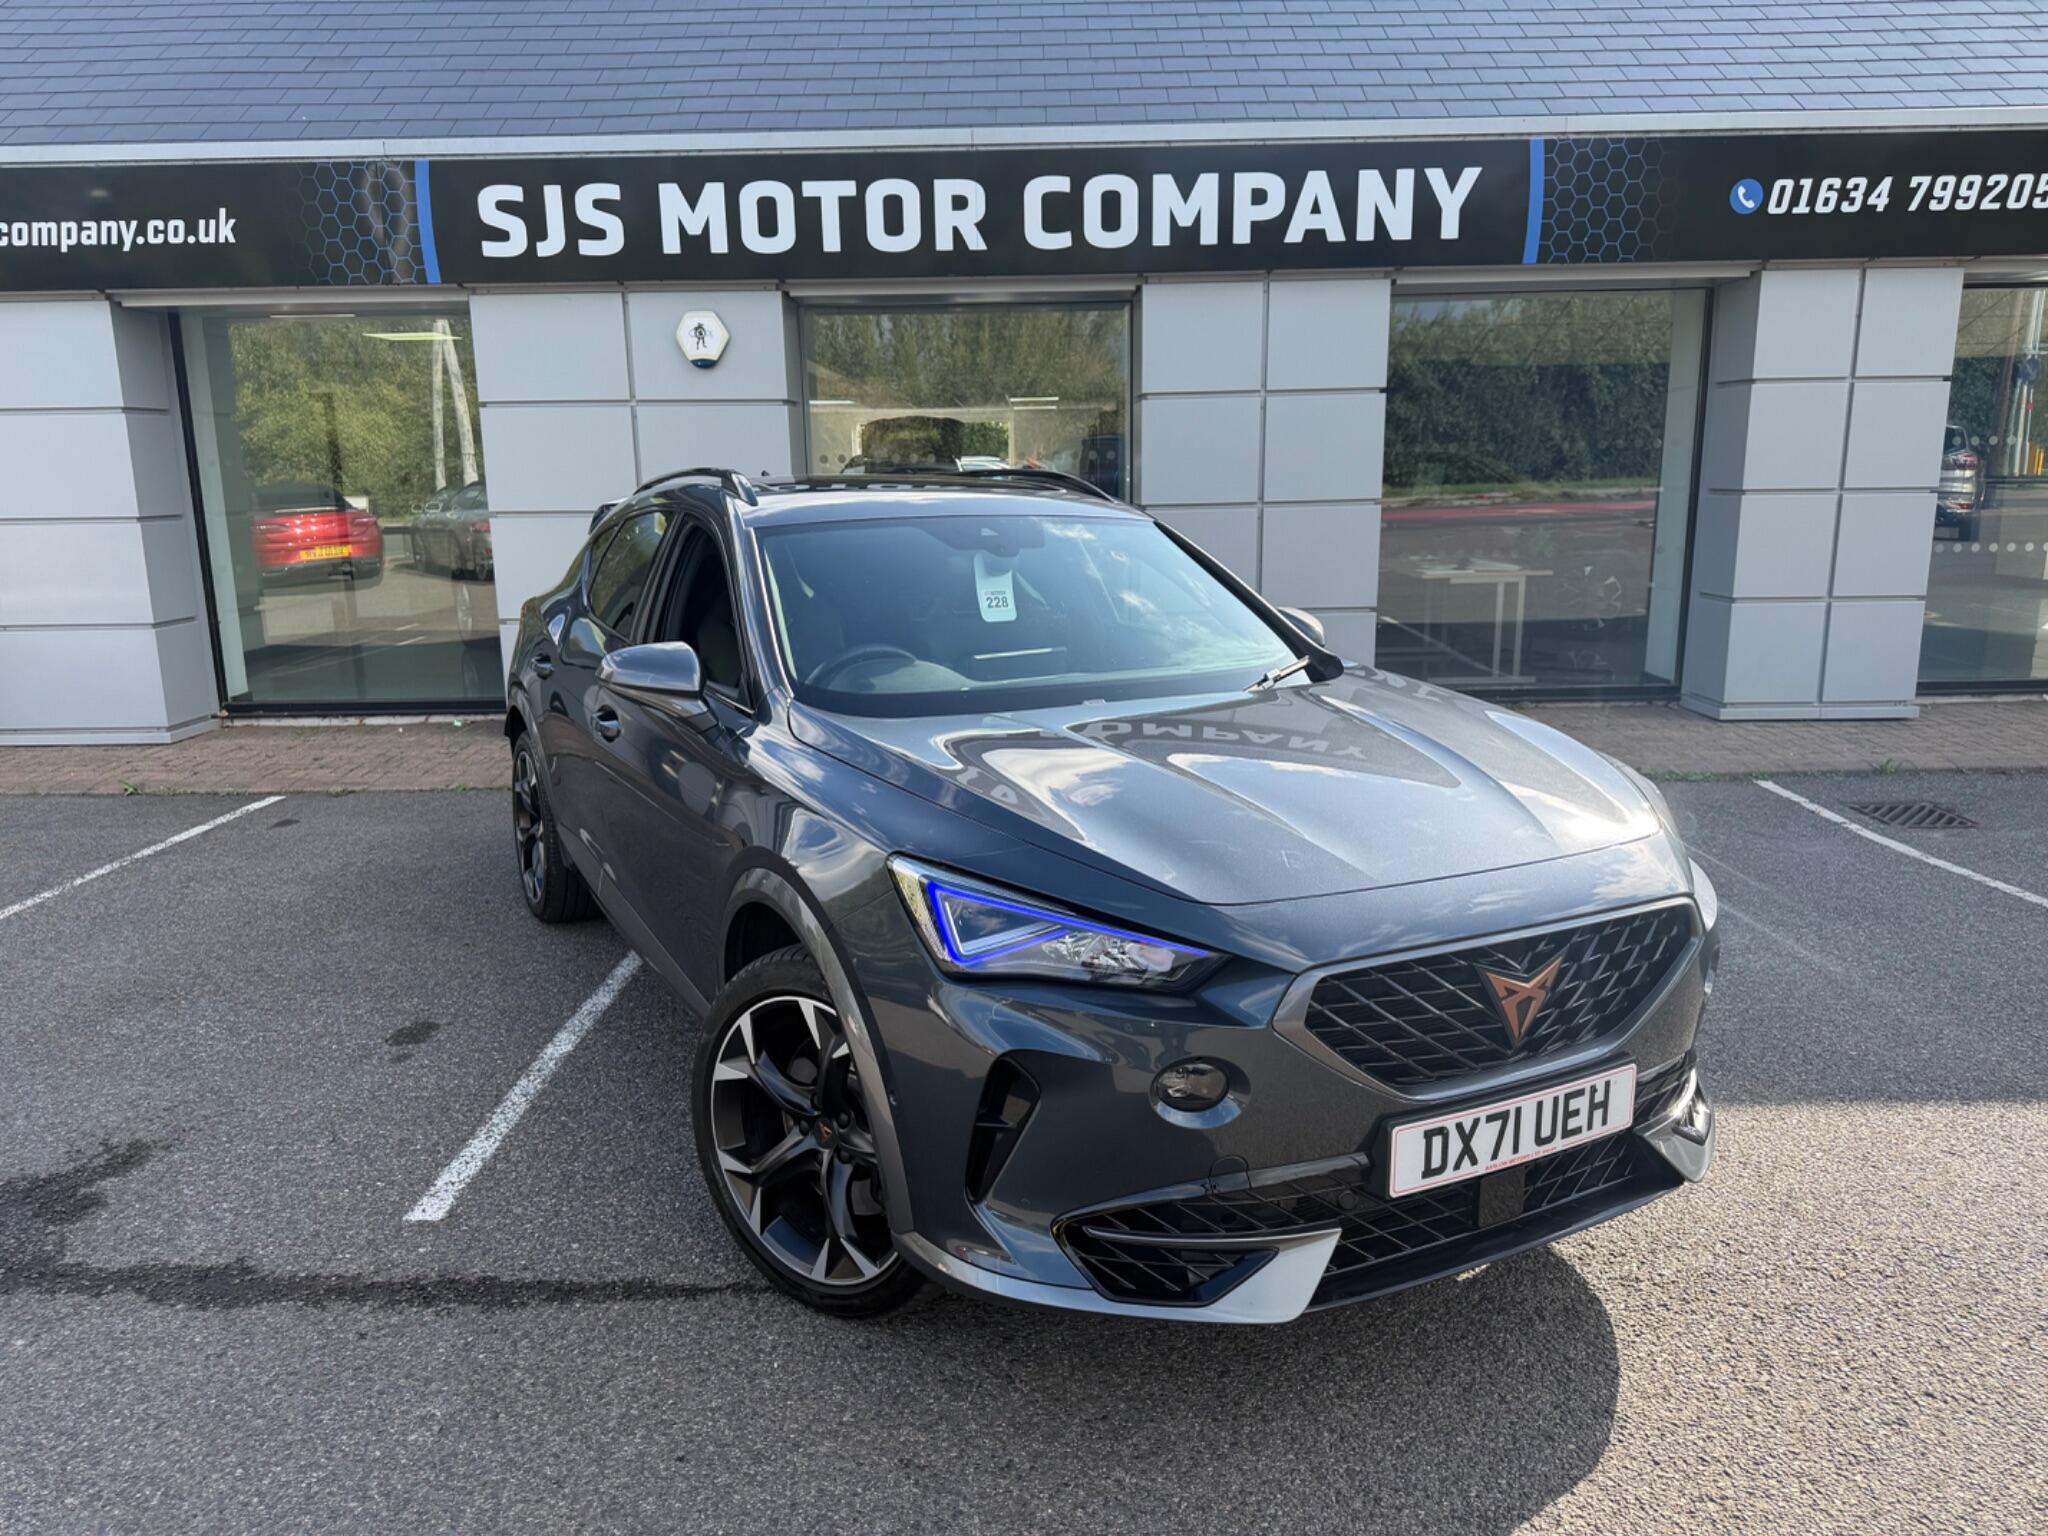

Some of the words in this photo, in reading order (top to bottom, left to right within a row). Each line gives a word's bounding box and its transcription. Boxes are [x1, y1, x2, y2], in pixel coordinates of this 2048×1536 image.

[478, 182, 625, 258] SJS
[658, 178, 988, 256] MOTOR
[1023, 166, 1483, 250] COMPANY
[1767, 175, 1893, 215] 01634
[1907, 173, 2048, 212] 799205
[986, 596, 1009, 609] 228
[1421, 1106, 1522, 1180] DX71
[1534, 1079, 1611, 1147] UEH
